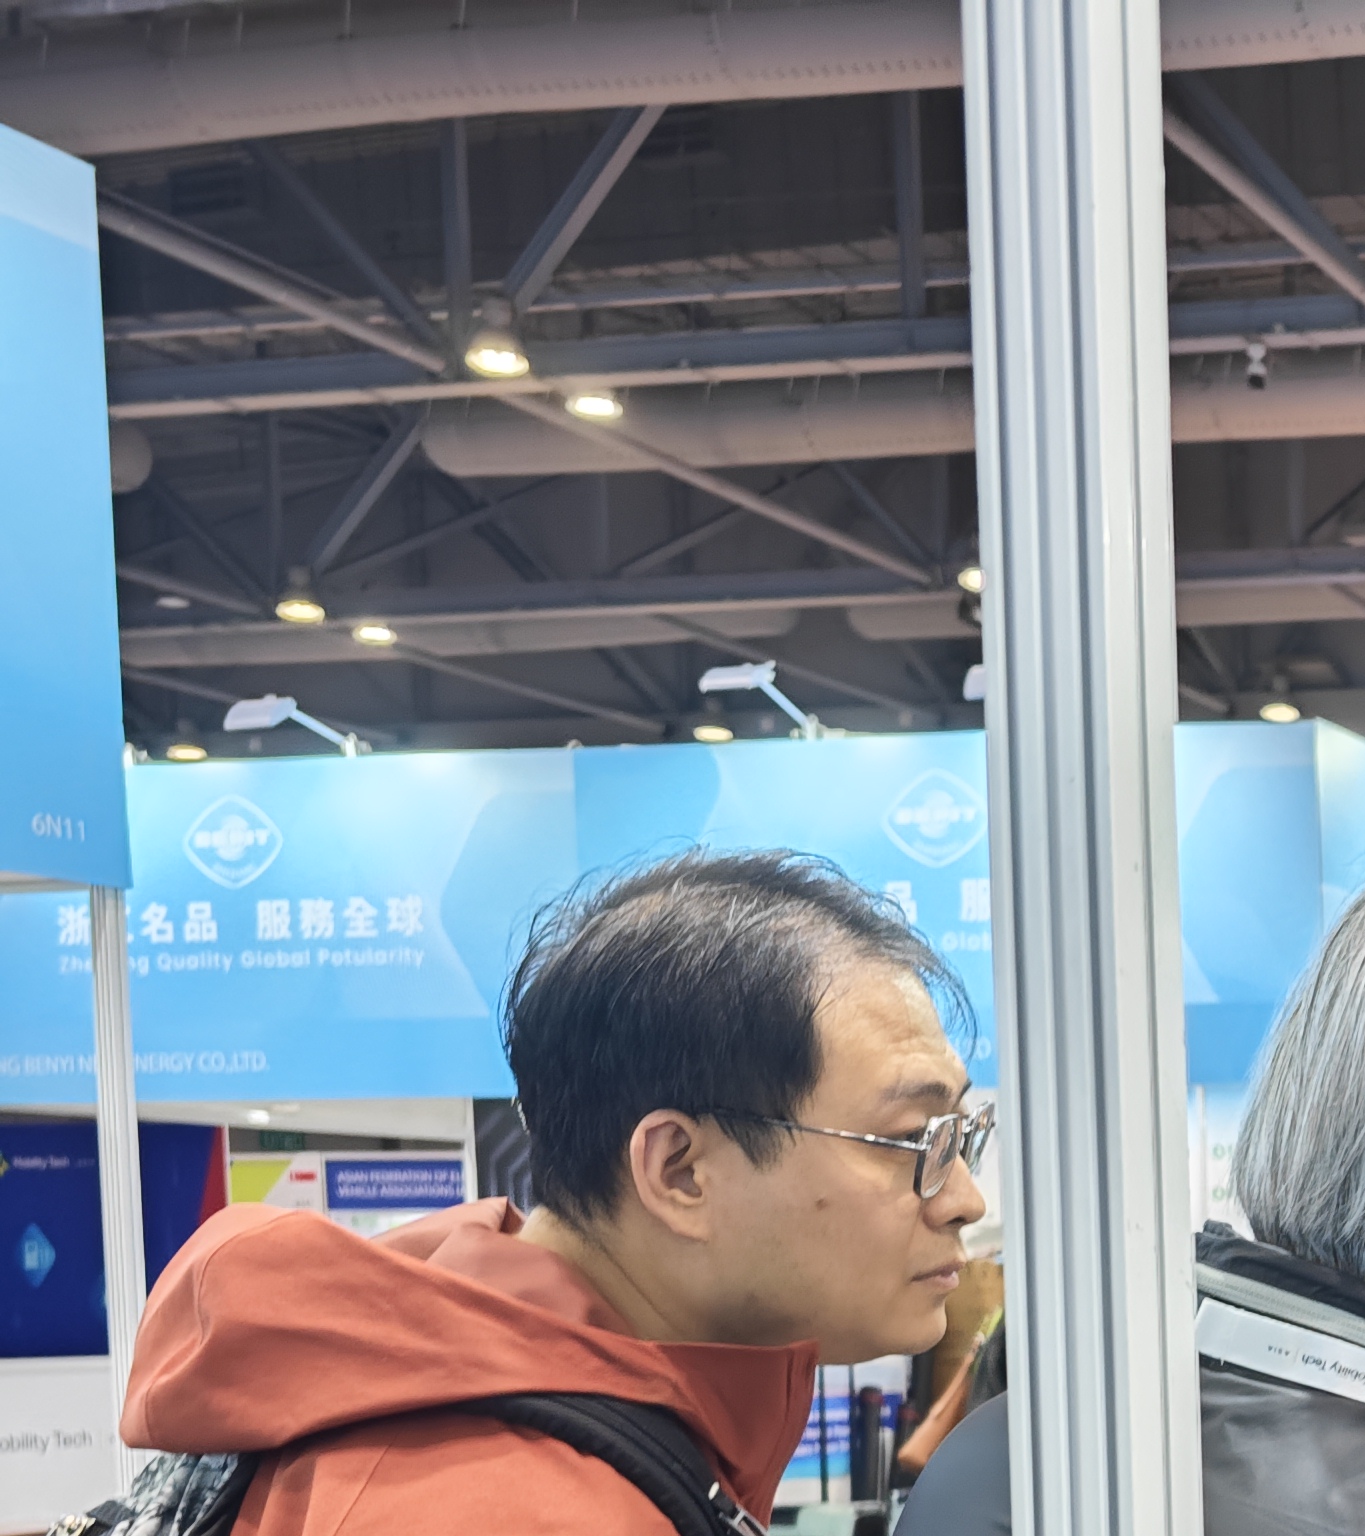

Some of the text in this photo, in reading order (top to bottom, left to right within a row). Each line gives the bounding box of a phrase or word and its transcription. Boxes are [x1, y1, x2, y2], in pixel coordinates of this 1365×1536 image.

[31, 813, 86, 841] 6N11
[57, 901, 219, 946] 浙名品
[157, 952, 233, 974] Quality
[241, 949, 311, 968] Global
[133, 1053, 194, 1072] NERGY
[1301, 1354, 1327, 1373] Tech
[0, 1430, 92, 1456] obility Tech
